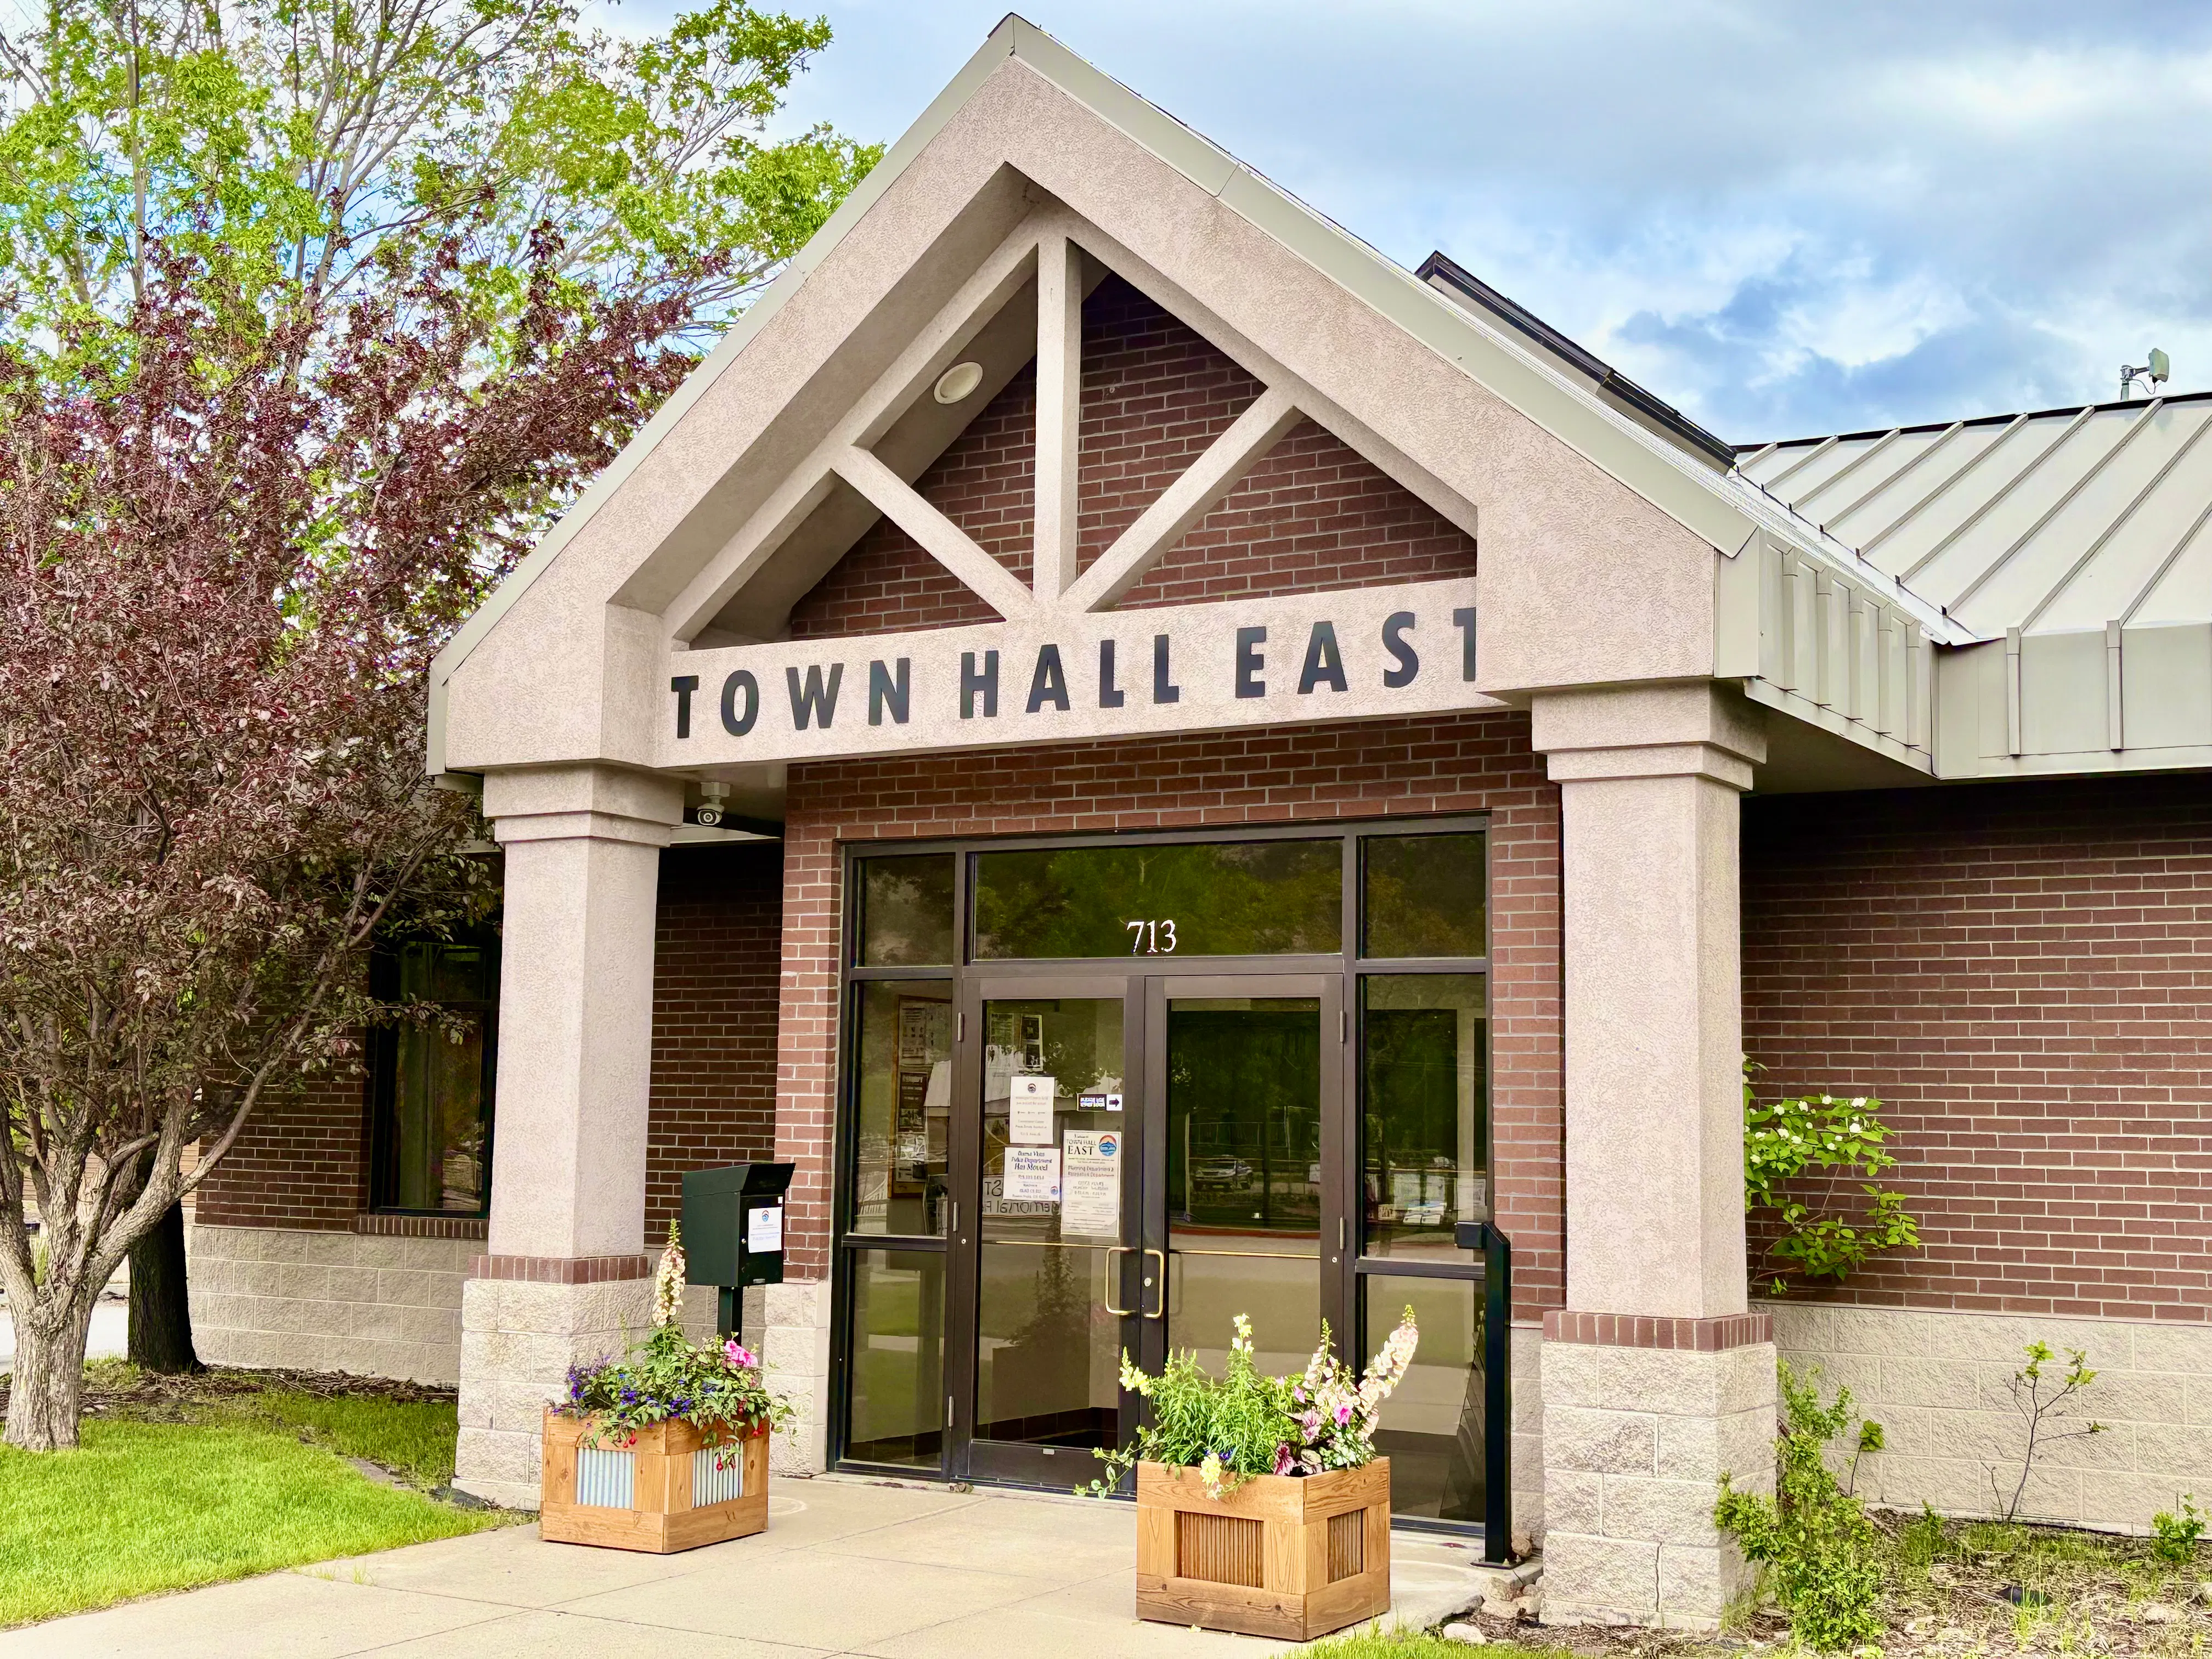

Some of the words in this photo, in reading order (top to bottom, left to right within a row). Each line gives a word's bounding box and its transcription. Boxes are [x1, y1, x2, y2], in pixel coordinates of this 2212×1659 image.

[671, 657, 911, 739] TOWN
[959, 634, 1180, 719] HALL
[1235, 606, 1477, 698] EAST
[1126, 919, 1177, 953] 713
[1068, 1145, 1095, 1155] EAST
